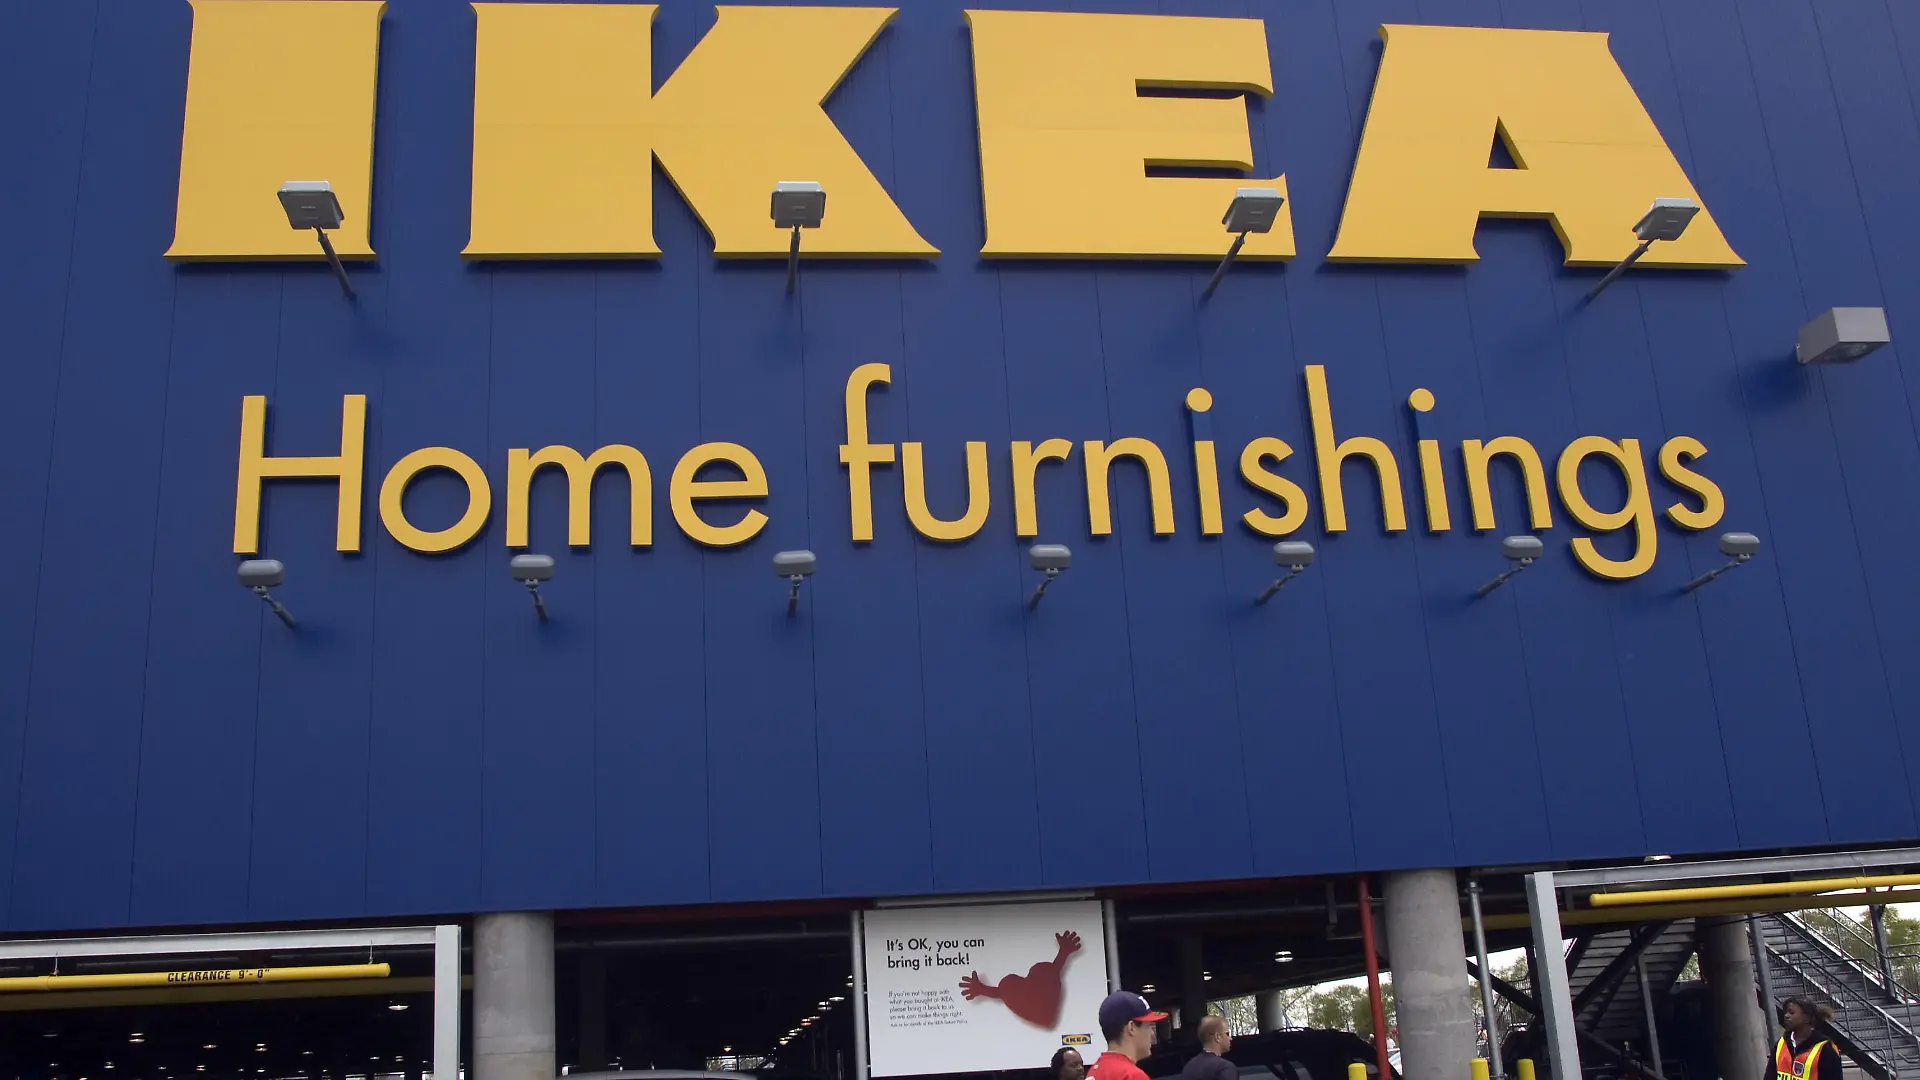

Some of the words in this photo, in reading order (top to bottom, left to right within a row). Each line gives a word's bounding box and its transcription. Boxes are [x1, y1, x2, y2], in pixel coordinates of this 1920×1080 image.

[164, 0, 1746, 268] IKEA
[233, 393, 770, 556] Home
[839, 363, 1726, 580] furnishings
[887, 940, 904, 951] It's
[908, 938, 932, 951] OK,
[936, 940, 958, 952] you
[964, 938, 984, 948] can
[888, 956, 920, 970] bring
[925, 955, 932, 966] it
[937, 952, 970, 966] back!
[168, 970, 231, 982] CLEARANCE
